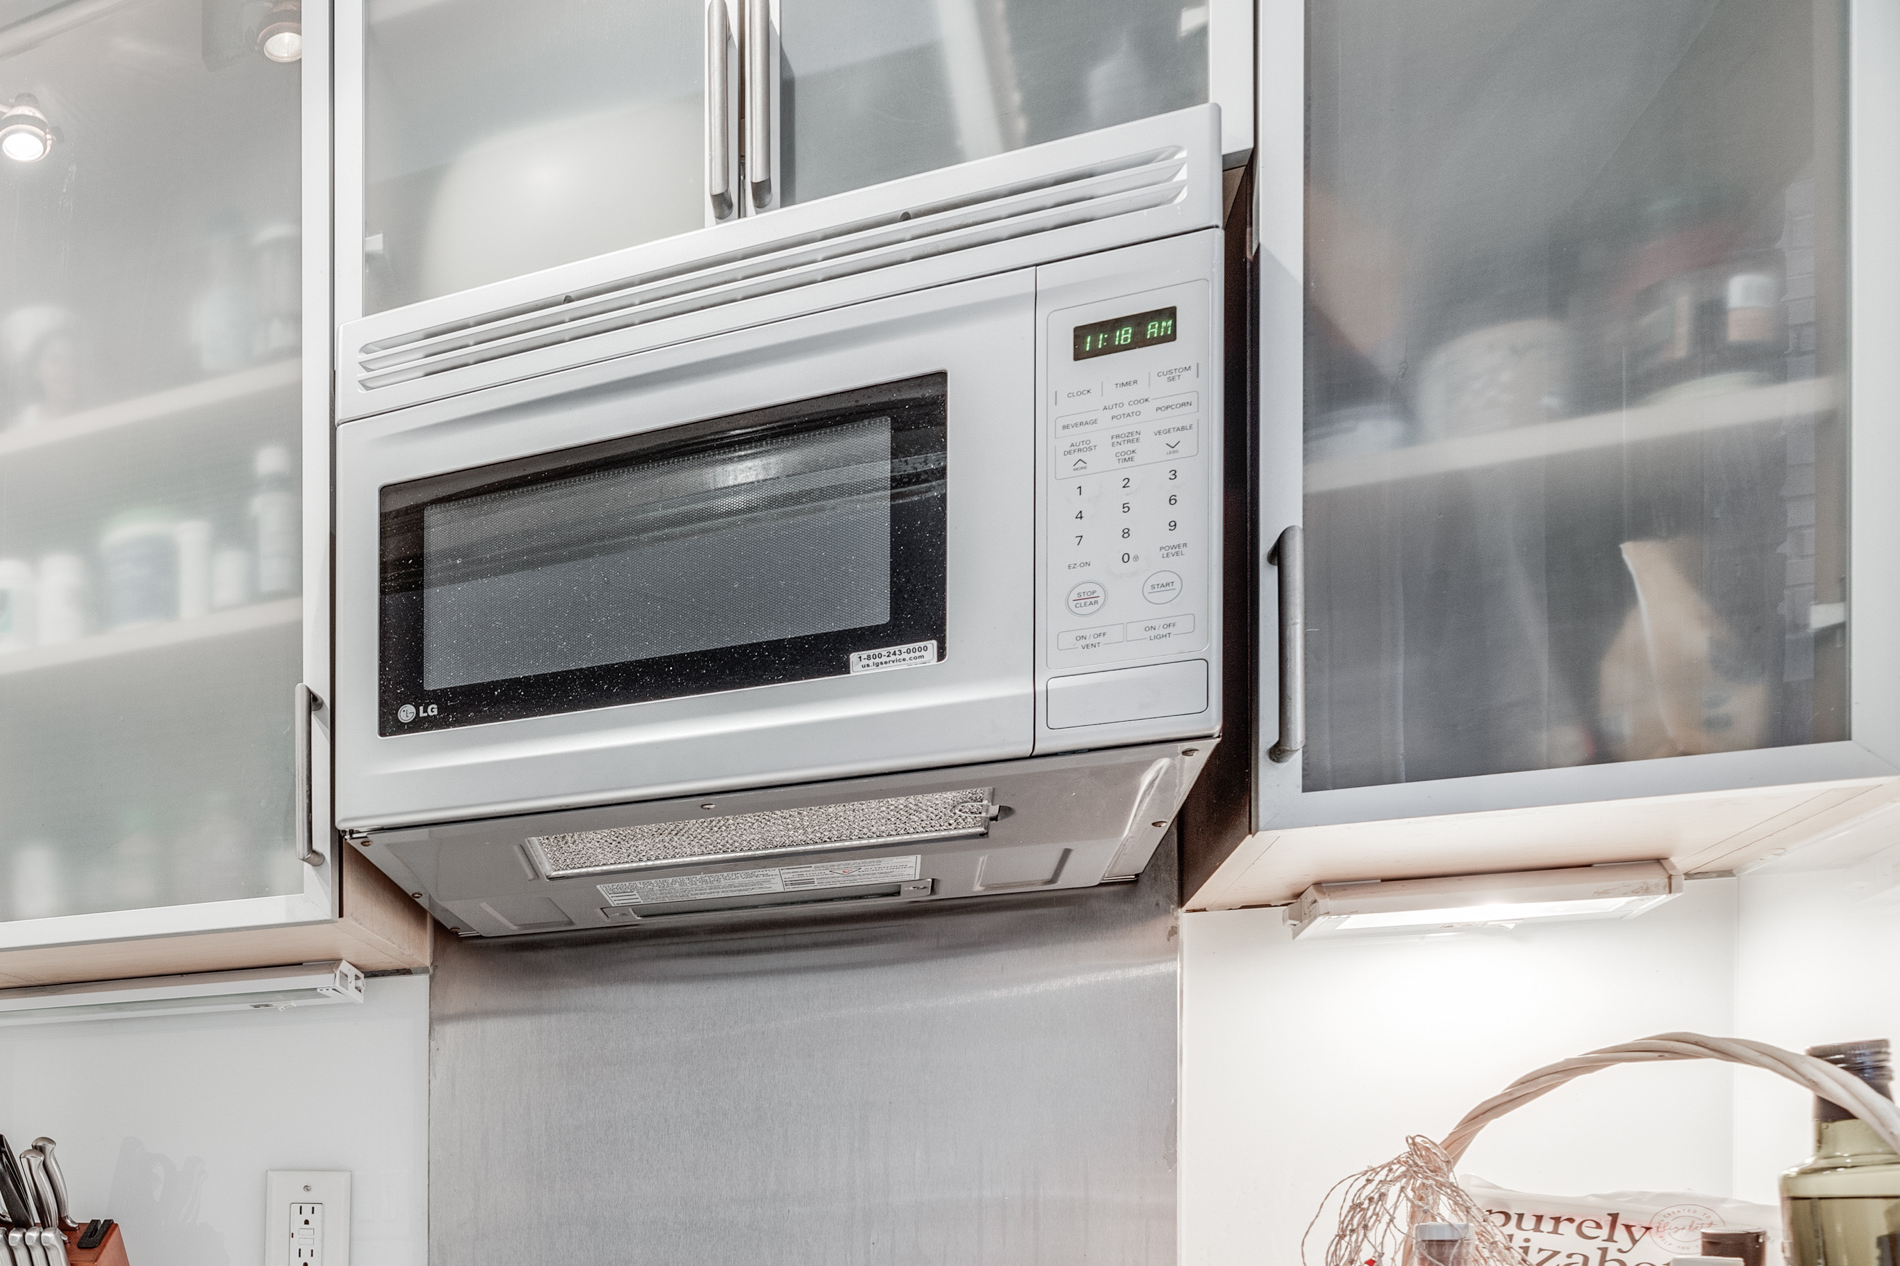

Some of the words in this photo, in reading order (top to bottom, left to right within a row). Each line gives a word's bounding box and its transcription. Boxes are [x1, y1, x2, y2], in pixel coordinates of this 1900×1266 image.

[1085, 326, 1132, 352] 11:18
[1146, 319, 1173, 339] AM
[1157, 366, 1191, 378] CUSTOM
[1167, 374, 1182, 383] SET
[1114, 379, 1138, 389] TIMER
[1067, 388, 1092, 398] CLOCK
[1103, 402, 1124, 411] AUTO
[1128, 397, 1150, 407] COOK
[1156, 401, 1192, 412] POPCORN
[1111, 410, 1141, 421] POTATO
[1062, 418, 1098, 430] BEVERAGE
[1111, 430, 1141, 440] FROZEN
[1154, 424, 1193, 436] VEGETABLE
[1070, 439, 1091, 448] AUTO
[1111, 437, 1140, 447] ENTREE
[1063, 445, 1097, 456] DEFROST
[1115, 449, 1137, 457] COOK
[1117, 456, 1135, 464] TIME
[1169, 470, 1177, 480] 3
[1122, 478, 1130, 489] 2
[1077, 486, 1082, 496] 1
[1169, 495, 1177, 505] 6
[1122, 503, 1130, 513] 5
[1075, 511, 1083, 520] 4
[1168, 520, 1177, 531] 9
[1122, 528, 1130, 539] 8
[1075, 535, 1083, 545] 7
[1159, 543, 1188, 552] POWER
[1122, 553, 1130, 563] 0
[1162, 550, 1185, 558] LEVEL
[1068, 562, 1091, 570] EZ-ON
[1150, 582, 1175, 590] START
[1077, 590, 1097, 598] STOP
[1075, 600, 1098, 608] CLEAR
[1149, 633, 1172, 641] LIGHT
[858, 645, 928, 662] 1-800-243-0000
[862, 654, 924, 668] us.lgservice.com
[419, 704, 438, 717] LG
[1663, 1209, 1698, 1218] CREATED
[1485, 1208, 1653, 1253] purely
